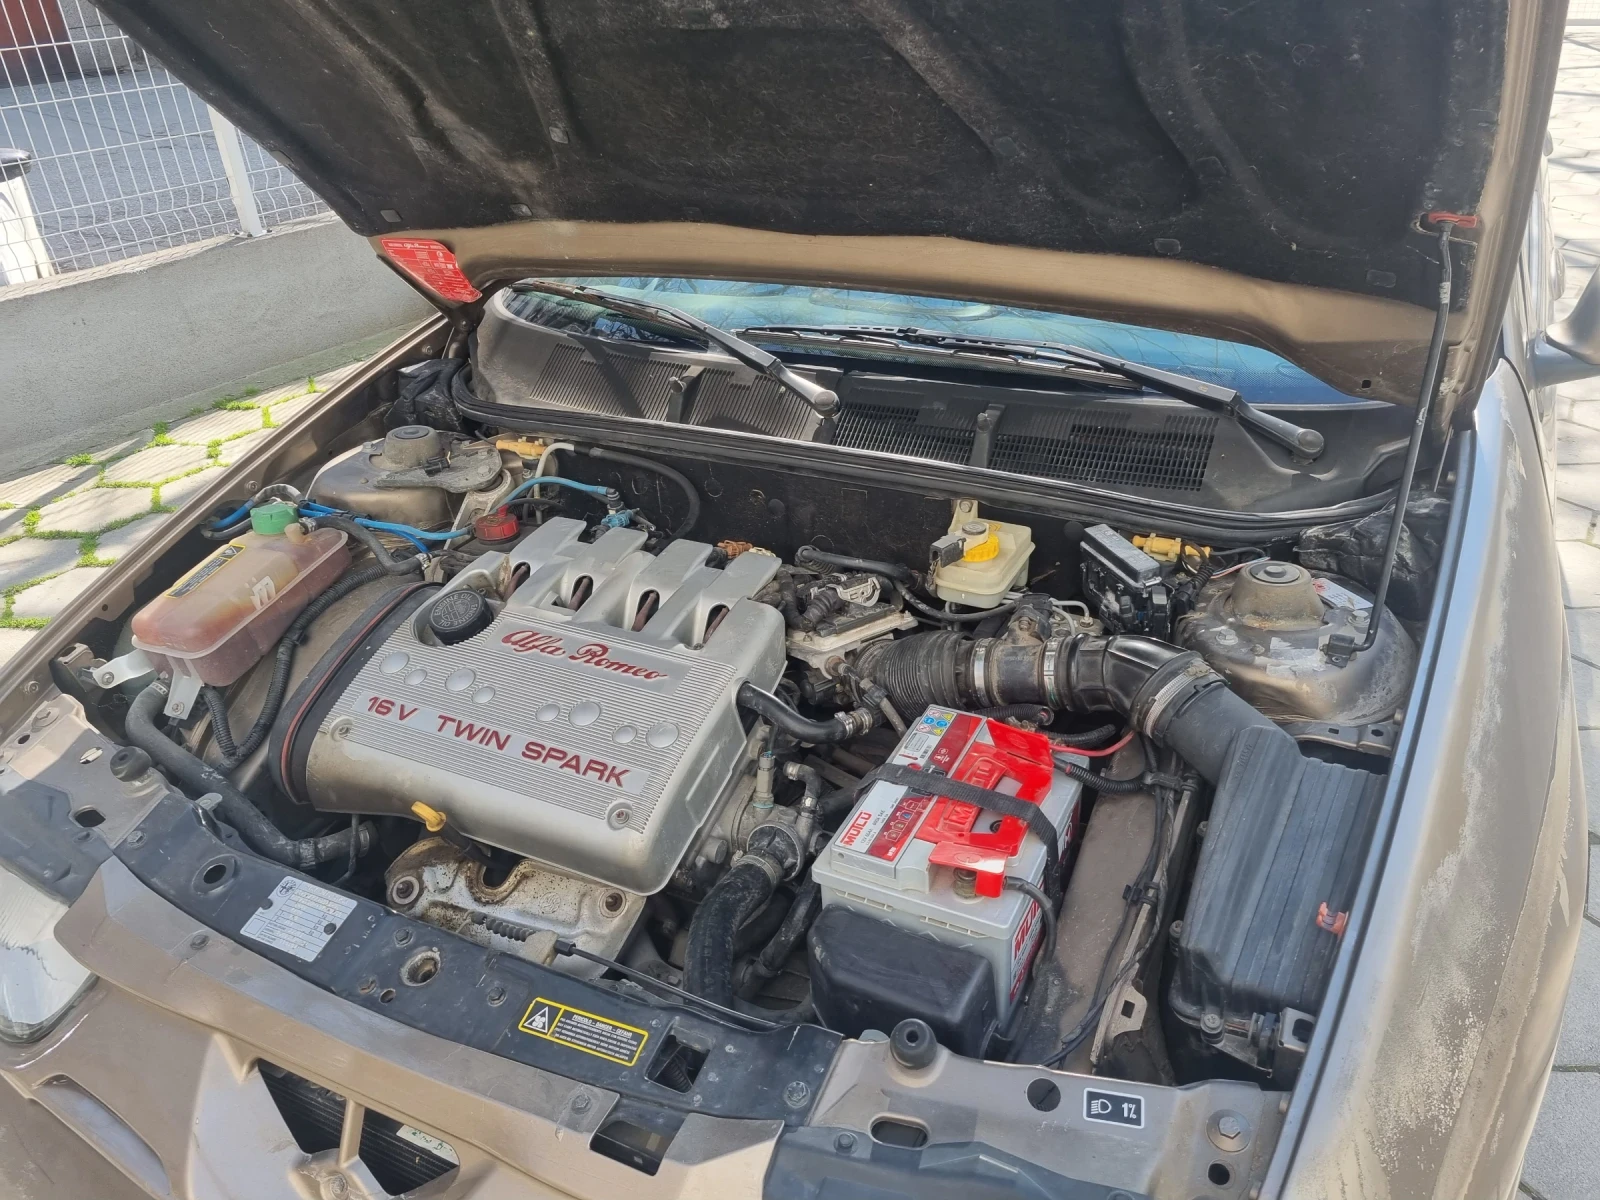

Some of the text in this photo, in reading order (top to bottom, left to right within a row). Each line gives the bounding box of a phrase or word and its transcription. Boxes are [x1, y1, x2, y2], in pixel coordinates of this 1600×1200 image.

[434, 592, 474, 616] ENGINE OIL
[501, 630, 669, 680] Alfa Romeo
[437, 714, 512, 752] TWIN
[521, 741, 632, 788] SPARK
[840, 811, 873, 846] MUTLU
[572, 1014, 593, 1025] PERICOLO
[595, 1021, 613, 1032] DANGER
[615, 1028, 633, 1038] GEFAHR
[1121, 1102, 1137, 1119] 1%
